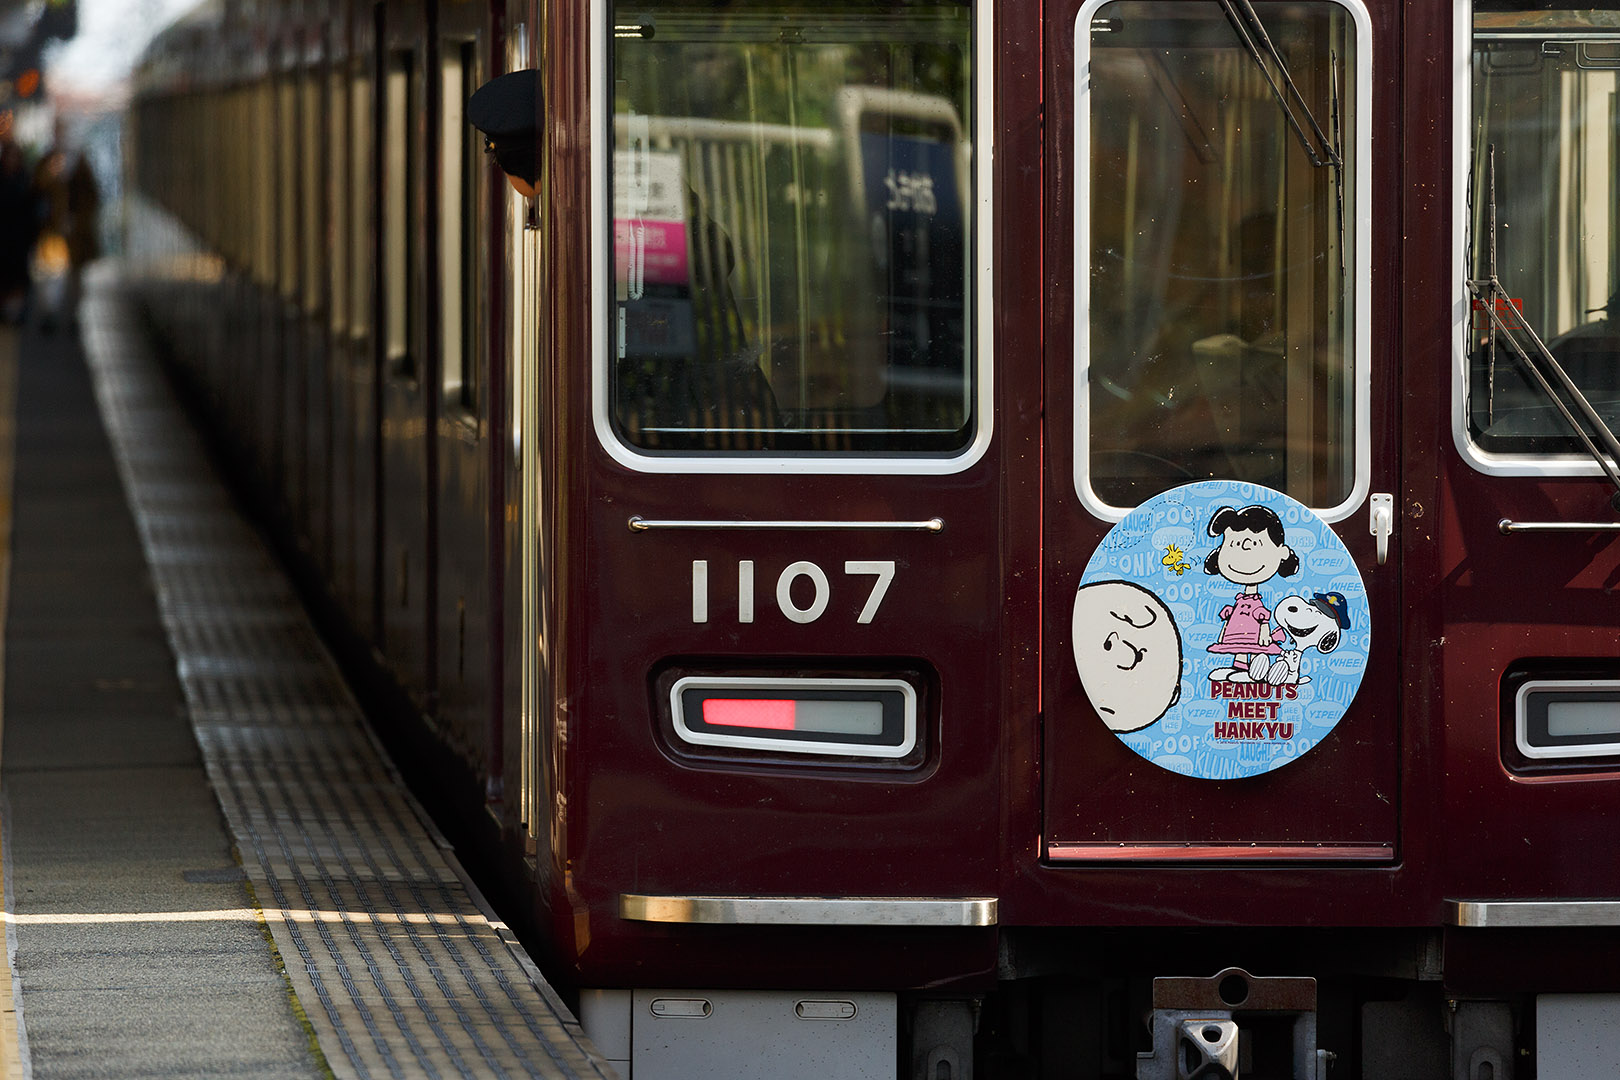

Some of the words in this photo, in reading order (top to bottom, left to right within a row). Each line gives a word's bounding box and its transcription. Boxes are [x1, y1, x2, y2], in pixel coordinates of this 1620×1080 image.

[1156, 505, 1208, 525] POOF!
[1108, 551, 1160, 577] BONK!
[1311, 558, 1345, 568] YIPE!!
[692, 560, 895, 623] 1107
[1329, 658, 1364, 668] WHEE!
[1210, 681, 1299, 700] PEANUTS
[1188, 709, 1220, 719] YIPE!!
[1227, 701, 1281, 720] MEET
[1213, 721, 1295, 740] HANKYU
[1153, 735, 1205, 753] POOF!
